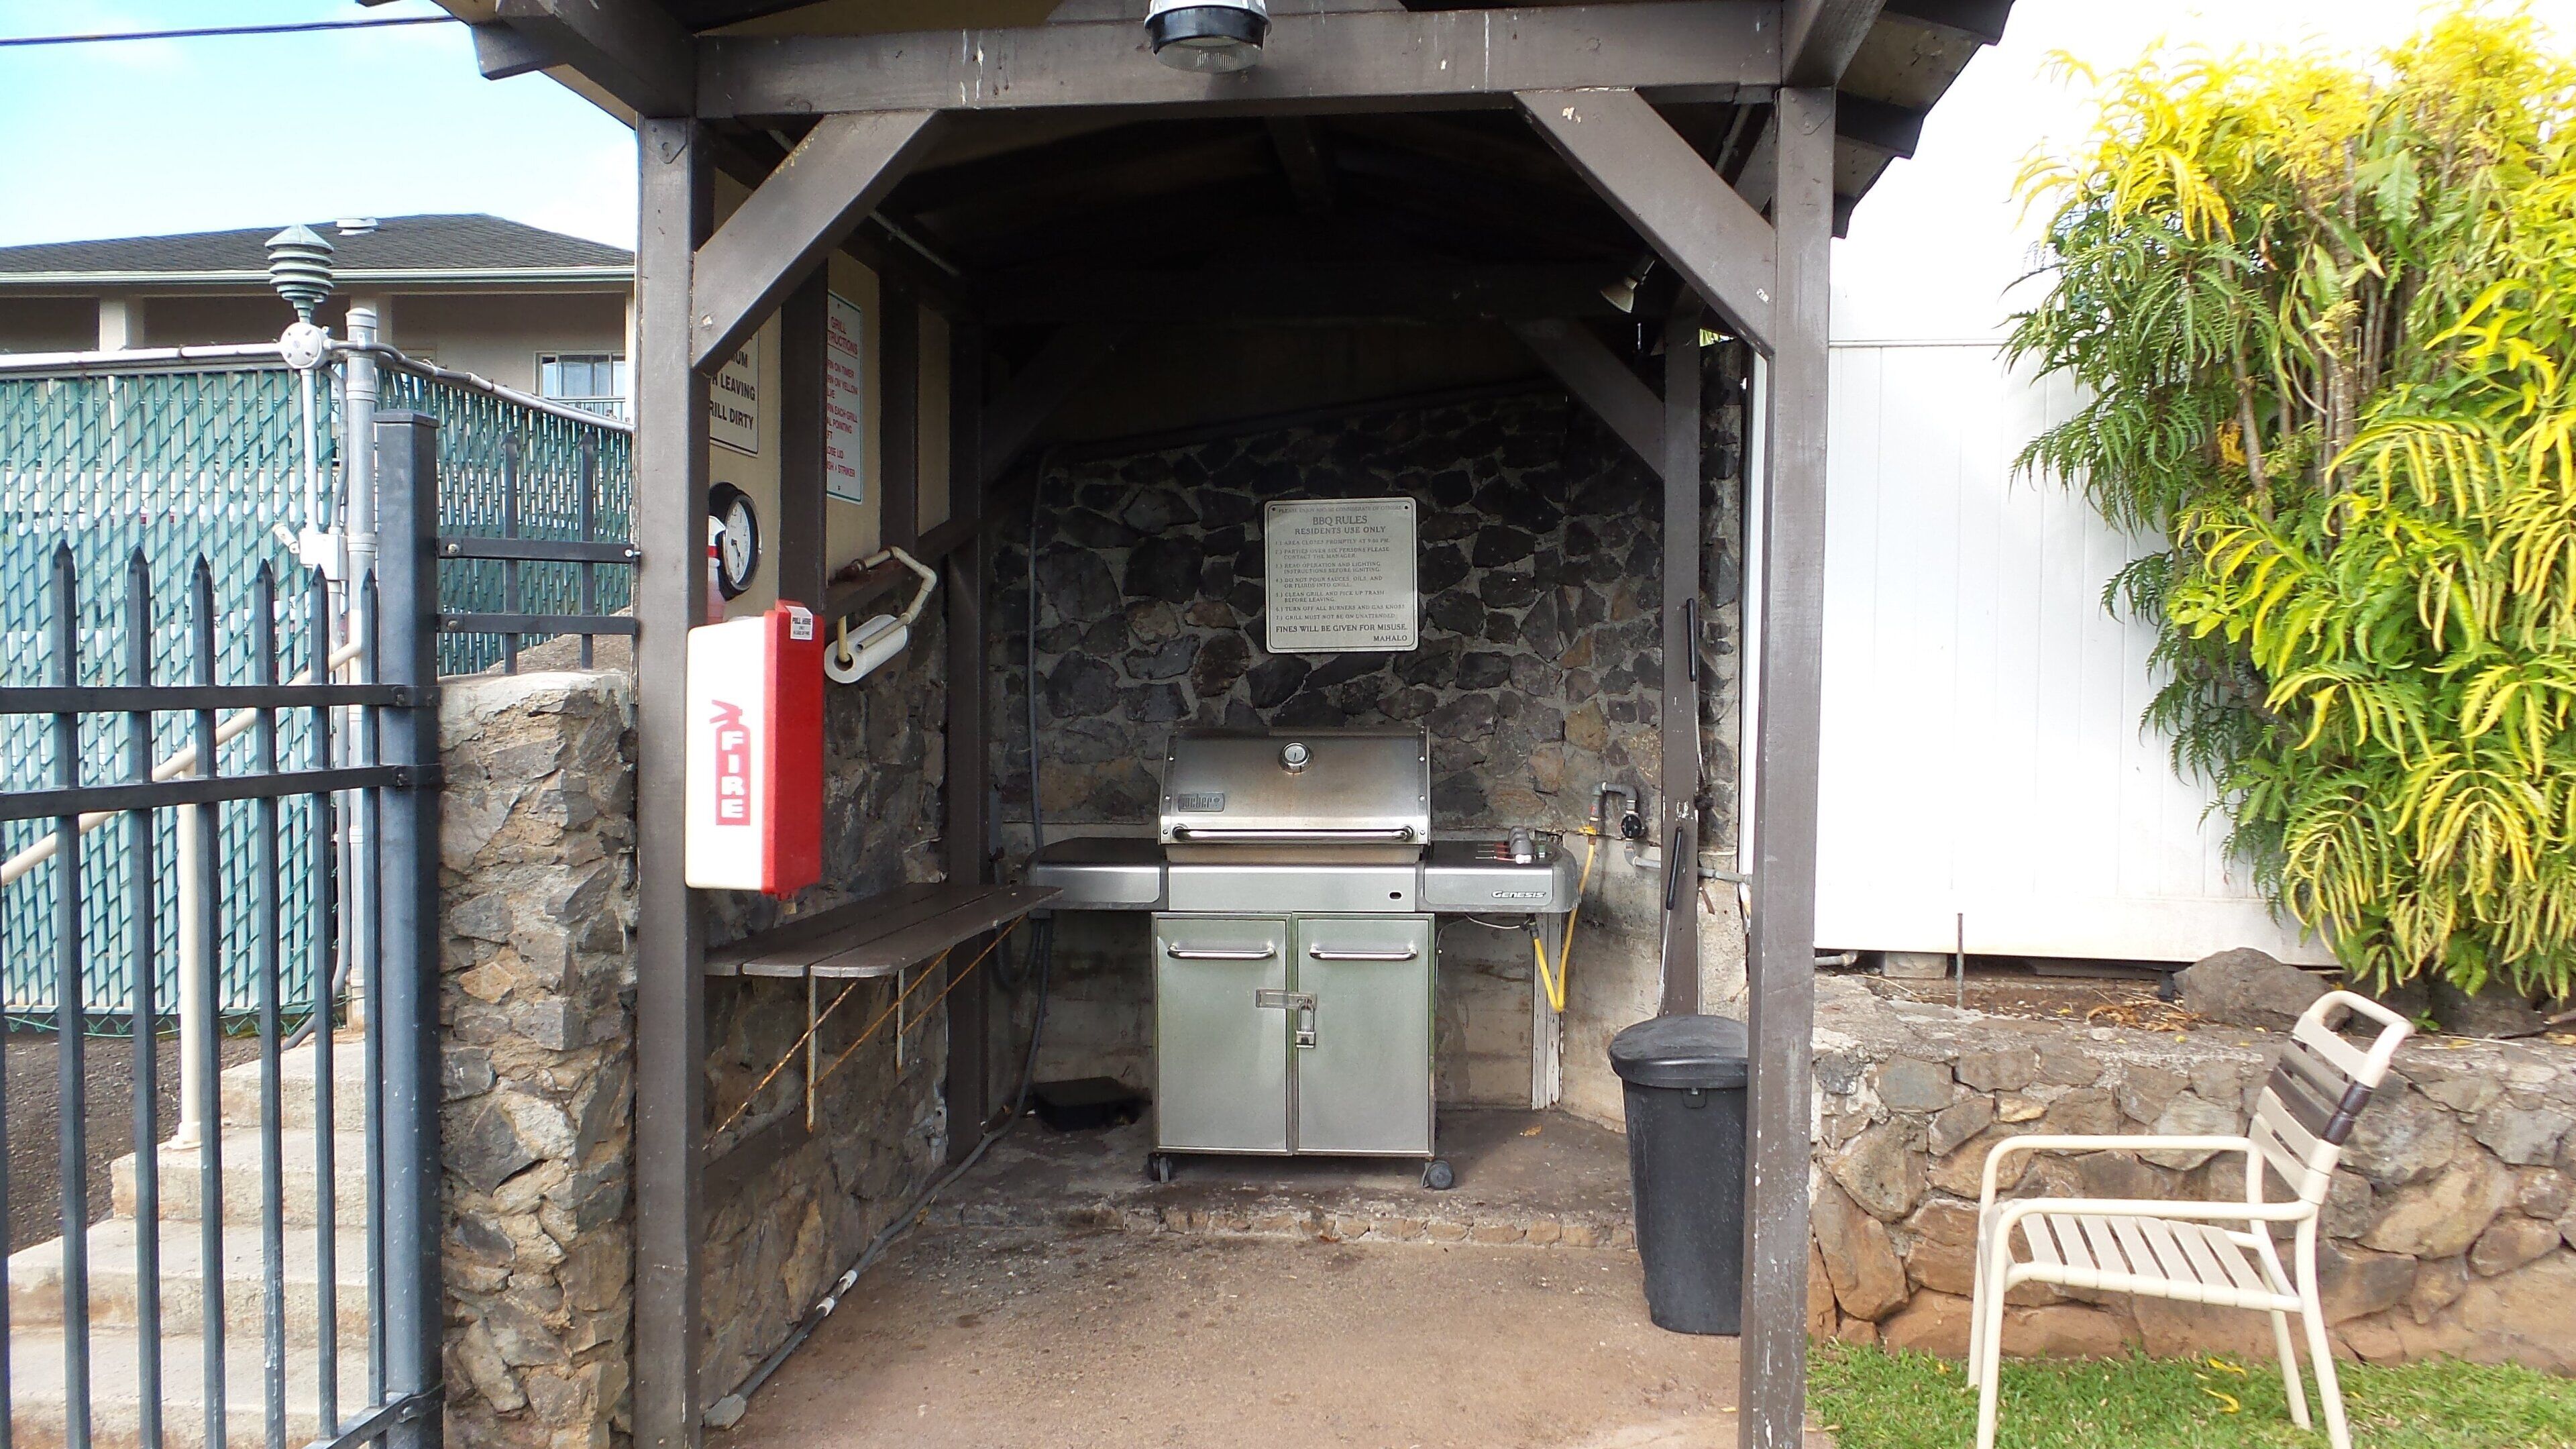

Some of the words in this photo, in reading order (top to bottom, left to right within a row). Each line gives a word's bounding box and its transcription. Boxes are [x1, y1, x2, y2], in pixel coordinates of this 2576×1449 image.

[828, 329, 858, 355] TRUCTIONS
[720, 373, 755, 401] LEAVING
[709, 400, 727, 421] RILL
[729, 408, 753, 430] DIRTY
[1313, 516, 1333, 526] BBQ
[1335, 515, 1368, 525] RULES
[721, 731, 745, 818] FIRE
[1182, 794, 1212, 808] weber
